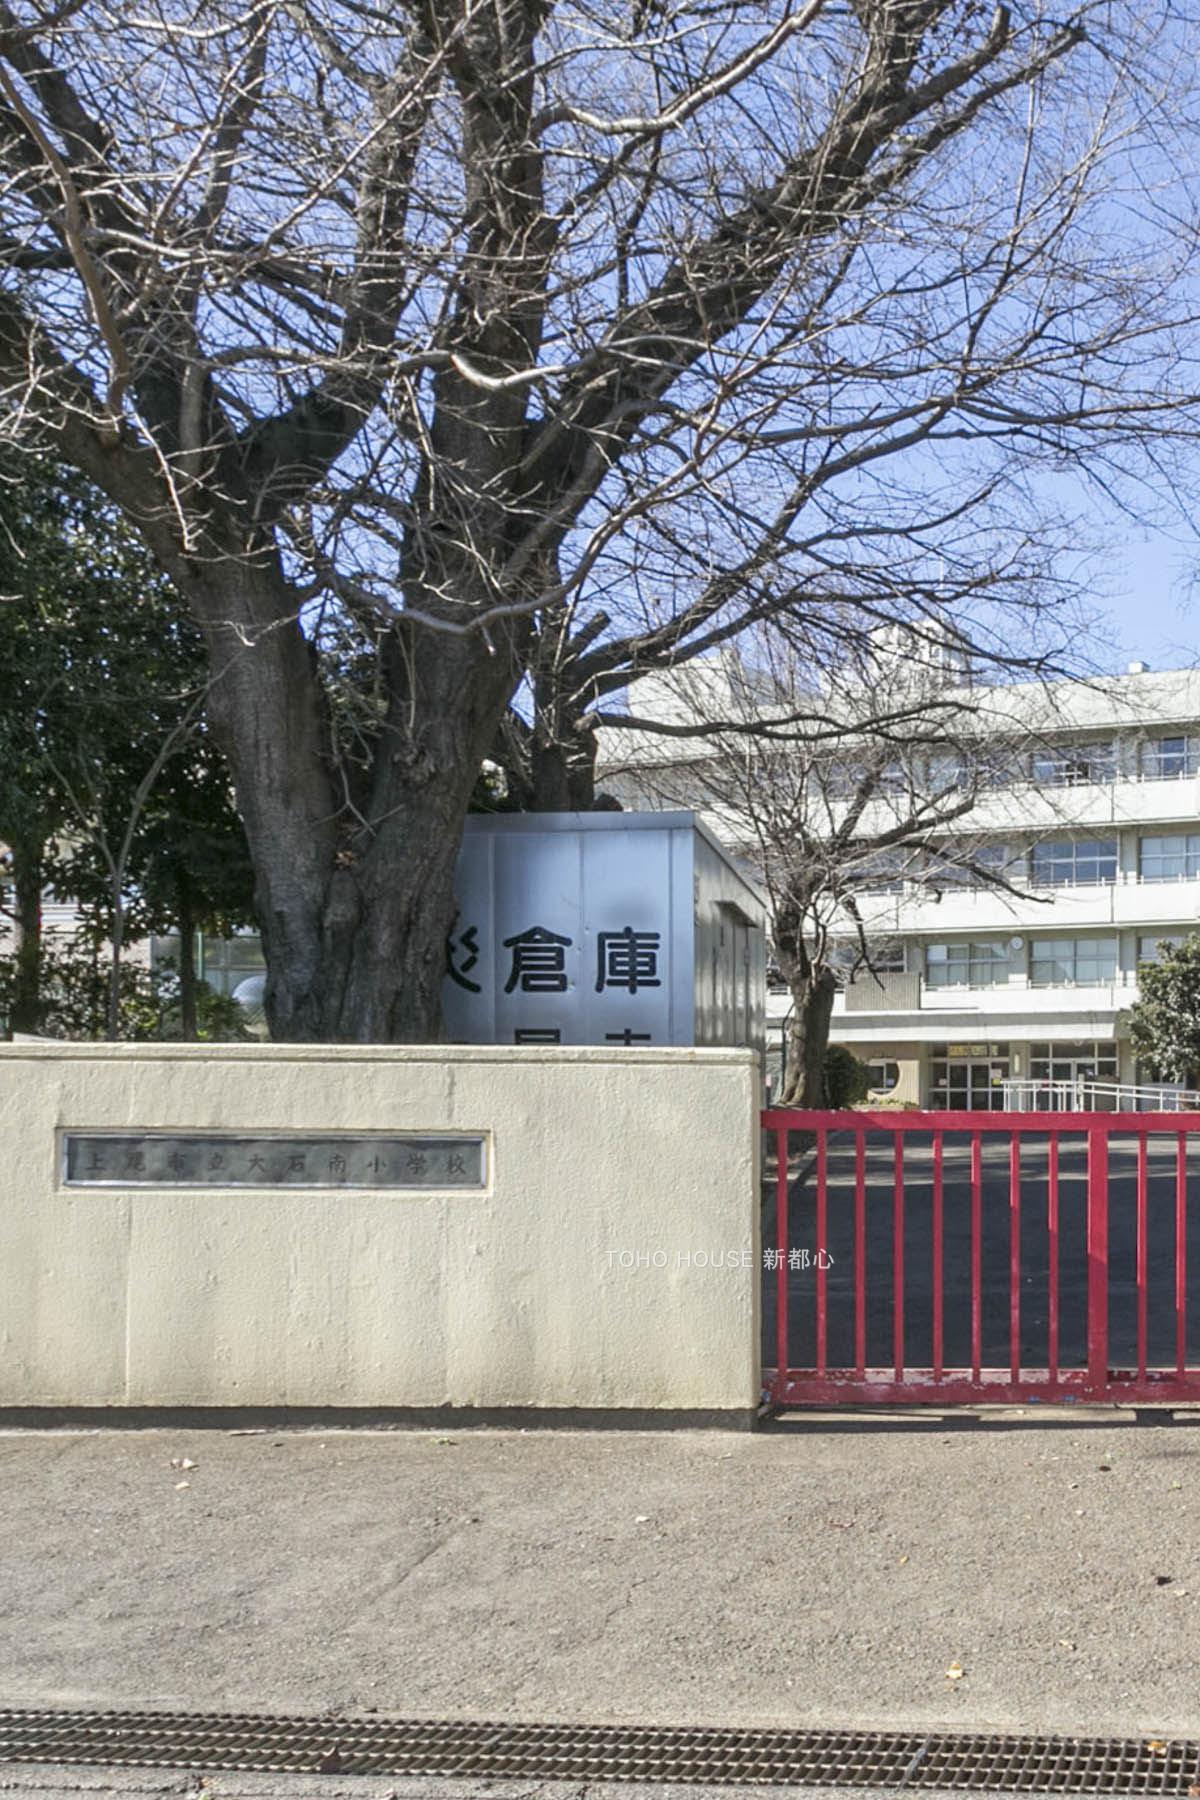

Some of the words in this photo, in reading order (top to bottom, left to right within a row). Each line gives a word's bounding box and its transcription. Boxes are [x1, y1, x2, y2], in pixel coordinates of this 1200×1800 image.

[85, 1151, 466, 1175] 上尾市立大石南小学校
